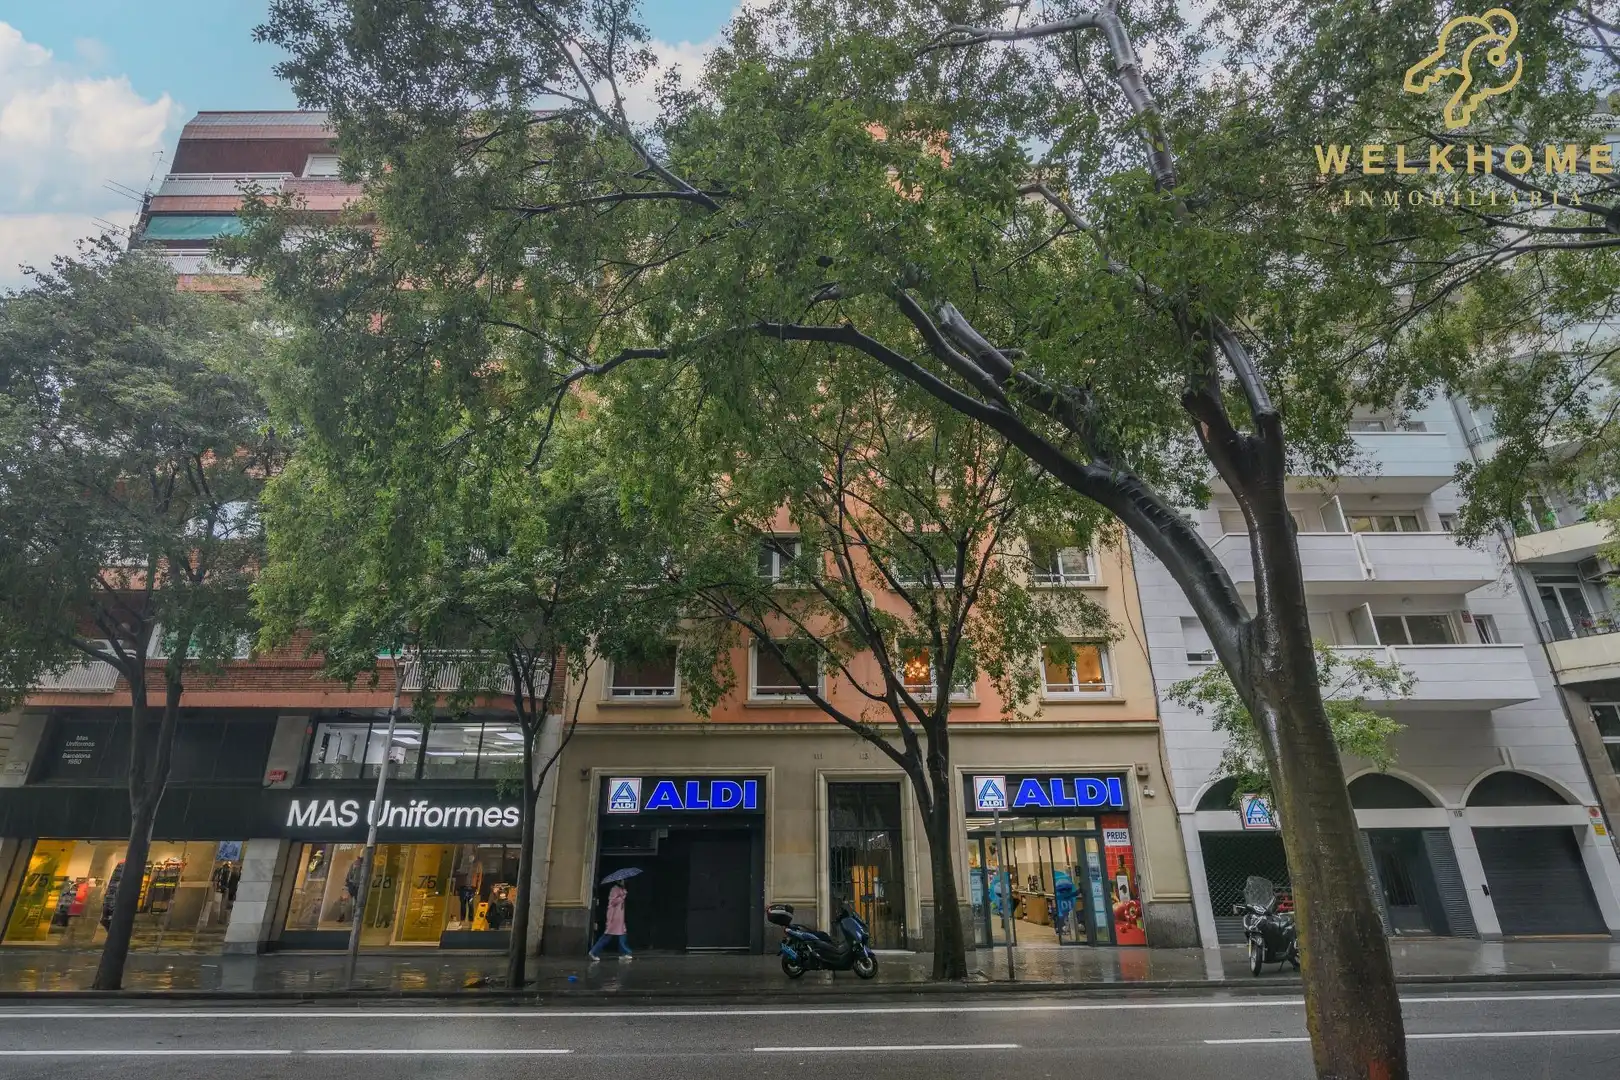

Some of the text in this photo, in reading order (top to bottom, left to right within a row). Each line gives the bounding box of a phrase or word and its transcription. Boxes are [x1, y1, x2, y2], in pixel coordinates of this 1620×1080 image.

[644, 780, 757, 809] ALDI
[1013, 777, 1124, 807] ALDI
[612, 802, 635, 810] ALDI
[982, 800, 1003, 808] ALDI
[286, 799, 520, 829] MAS Uniformes
[1250, 817, 1270, 825] ALDI
[1106, 831, 1128, 840] PREUS
